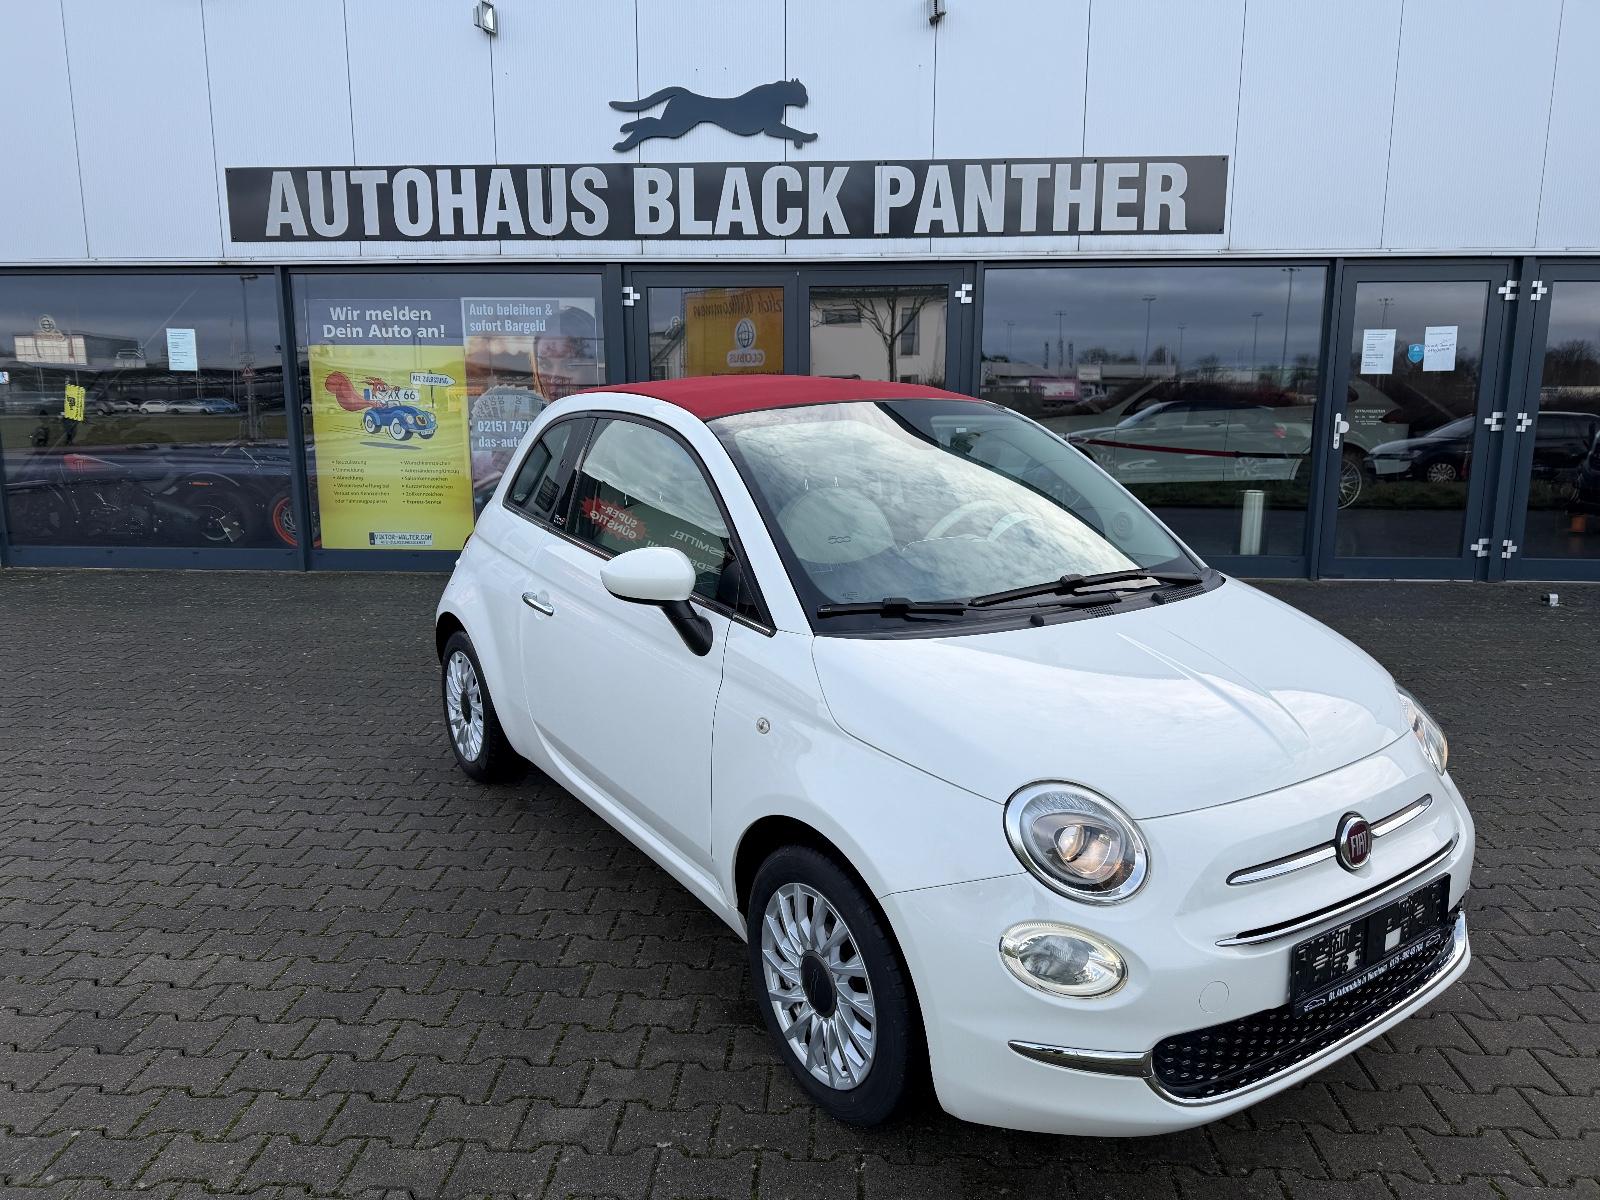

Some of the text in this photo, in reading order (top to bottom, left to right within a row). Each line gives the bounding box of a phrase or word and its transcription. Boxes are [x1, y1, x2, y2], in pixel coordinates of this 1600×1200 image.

[265, 162, 1188, 238] AUTOHAUS BLACK PANTHER
[329, 306, 432, 320] Wir melden
[469, 303, 553, 316] Auto beleihen &
[323, 324, 445, 338] Dein Auto an!
[470, 319, 546, 334] sofort Bargeld
[403, 390, 416, 400] 66
[477, 420, 507, 432] 02151
[1350, 830, 1367, 858] FIAT
